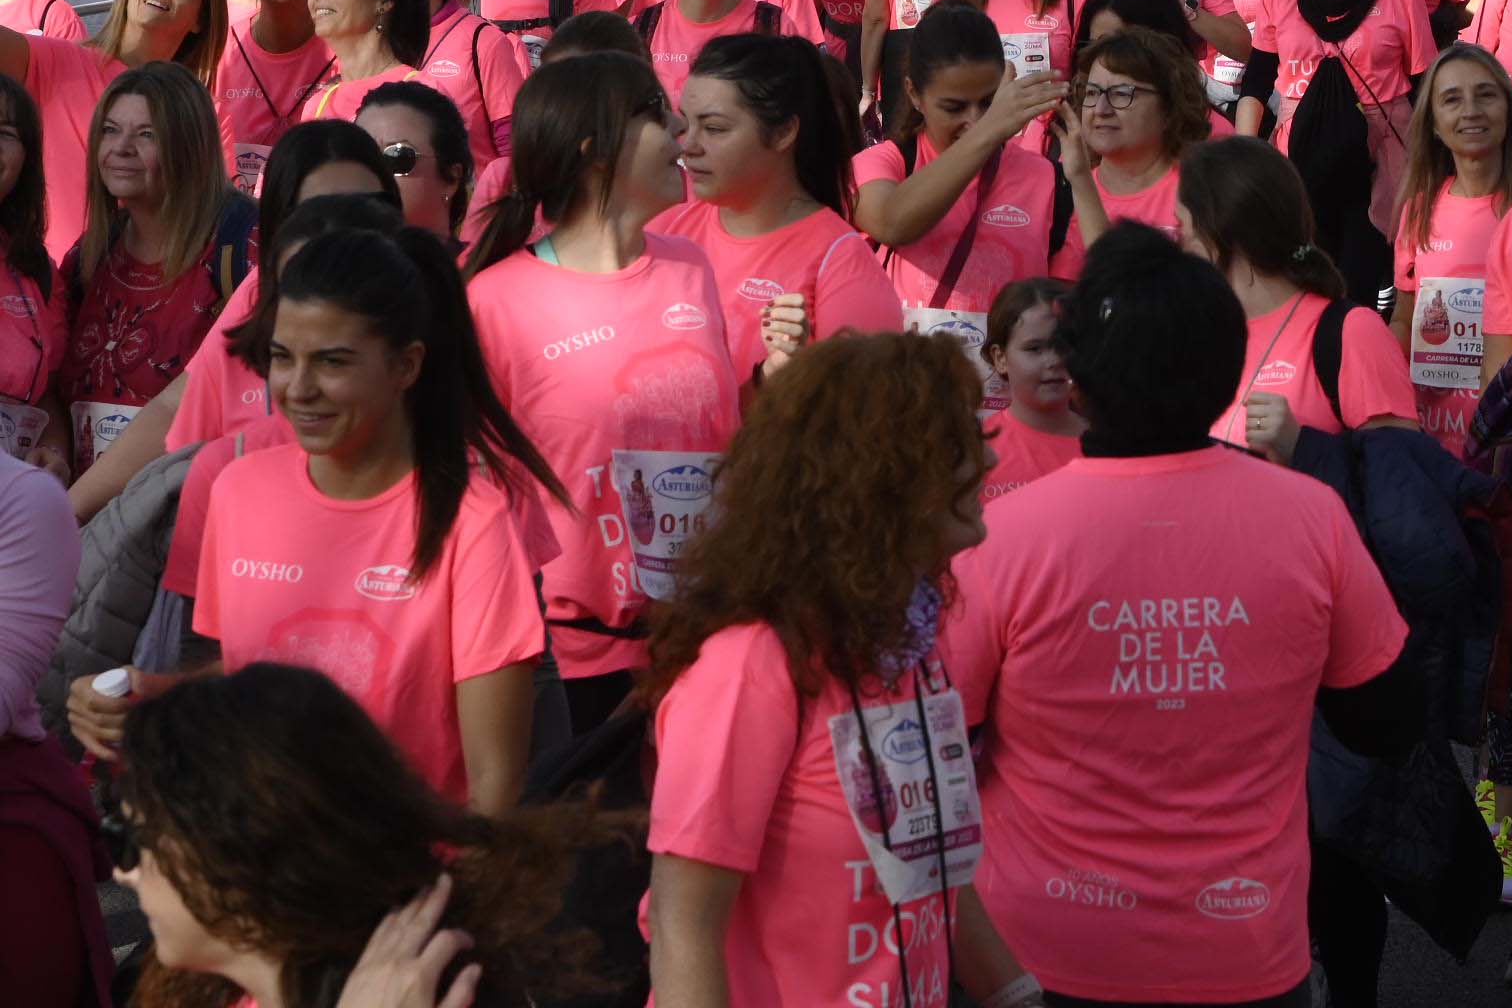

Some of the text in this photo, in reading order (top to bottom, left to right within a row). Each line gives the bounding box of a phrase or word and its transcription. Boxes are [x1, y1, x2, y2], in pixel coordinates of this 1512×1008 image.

[826, 1, 863, 17] DOR
[1453, 321, 1484, 338] 01
[543, 324, 616, 361] OYSHO
[1457, 342, 1484, 353] 1178
[1426, 354, 1459, 363] CARRERA
[1421, 369, 1459, 380] OYSHO
[231, 557, 303, 584] OYSHO
[1087, 596, 1250, 632] CARRERA
[1119, 631, 1219, 663] DE LA
[1111, 662, 1226, 694] MUJER
[1156, 698, 1186, 710] 2023
[1046, 877, 1137, 911] OYSHO
